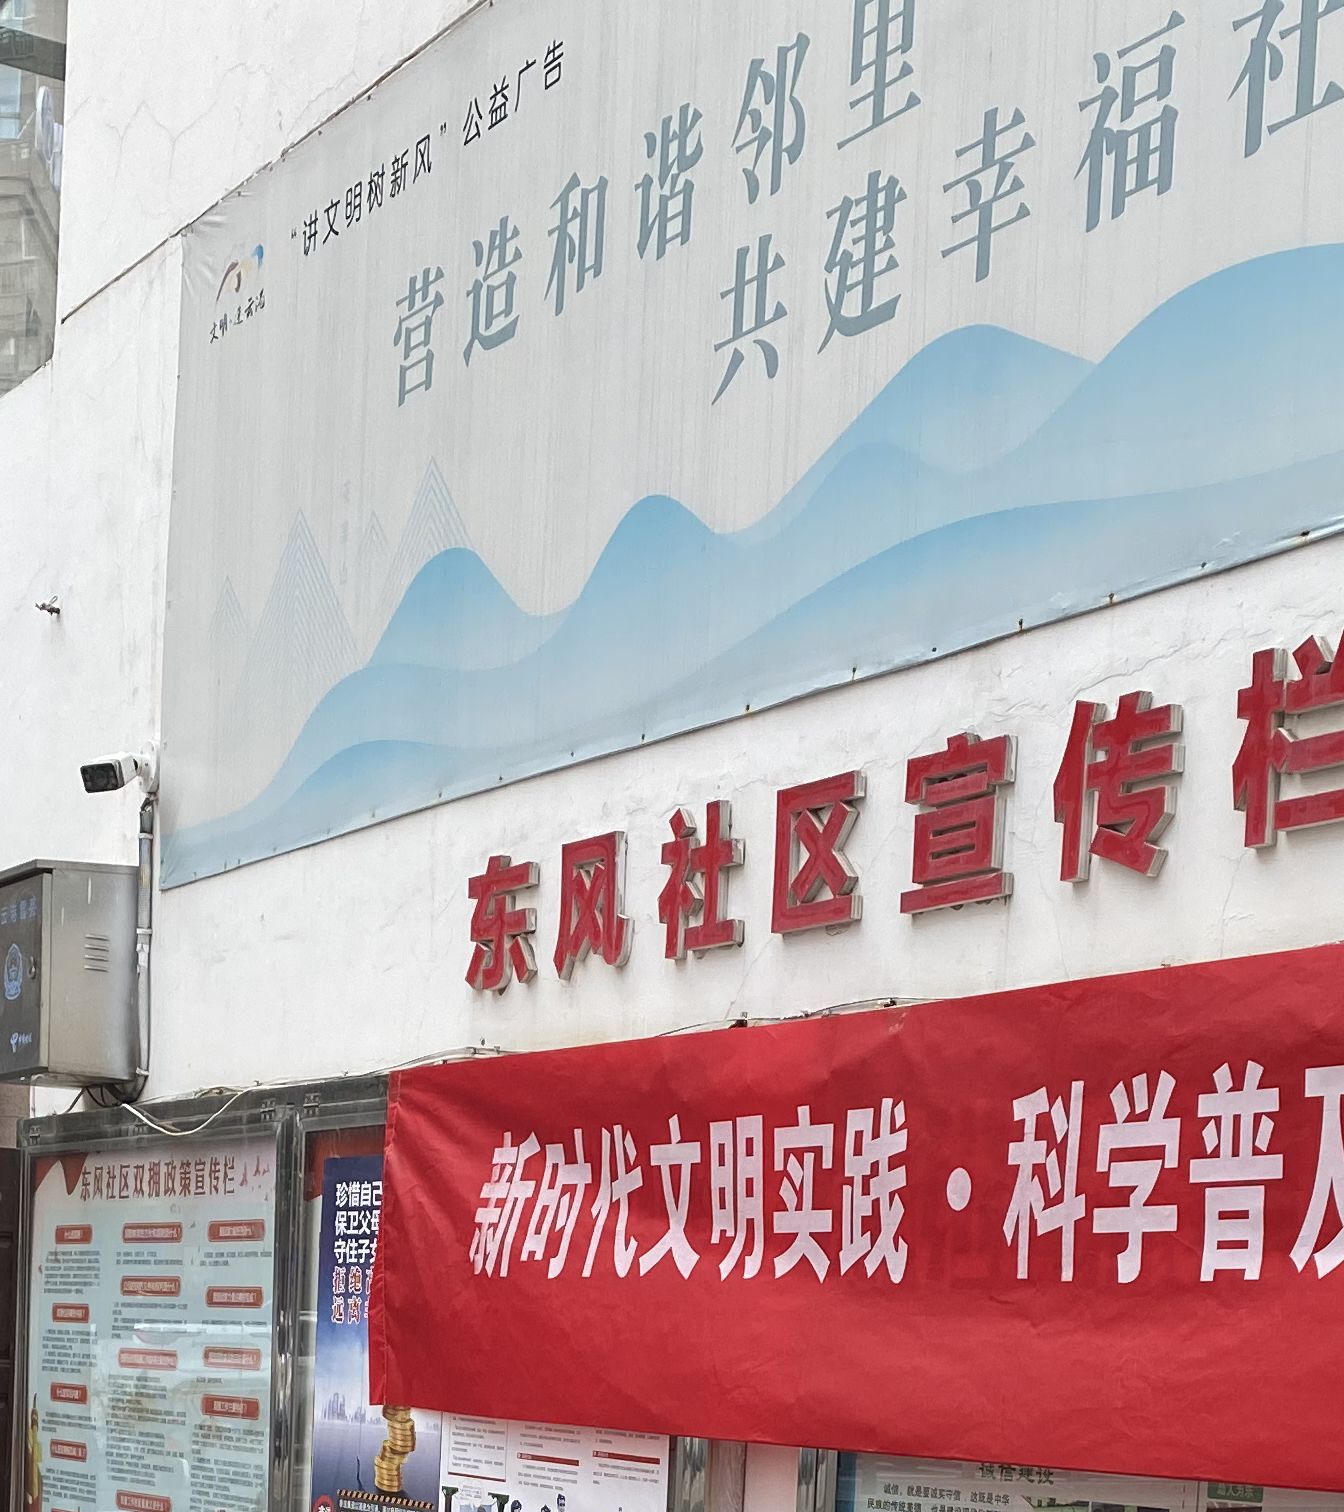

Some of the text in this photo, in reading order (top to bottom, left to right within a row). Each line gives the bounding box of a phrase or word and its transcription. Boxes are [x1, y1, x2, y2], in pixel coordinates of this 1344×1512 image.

[80, 1156, 235, 1201] 东风社区双拥政策宣传栏
[336, 1181, 383, 1207] 珍惜自己
[979, 1463, 1055, 1485] 诚信建设
